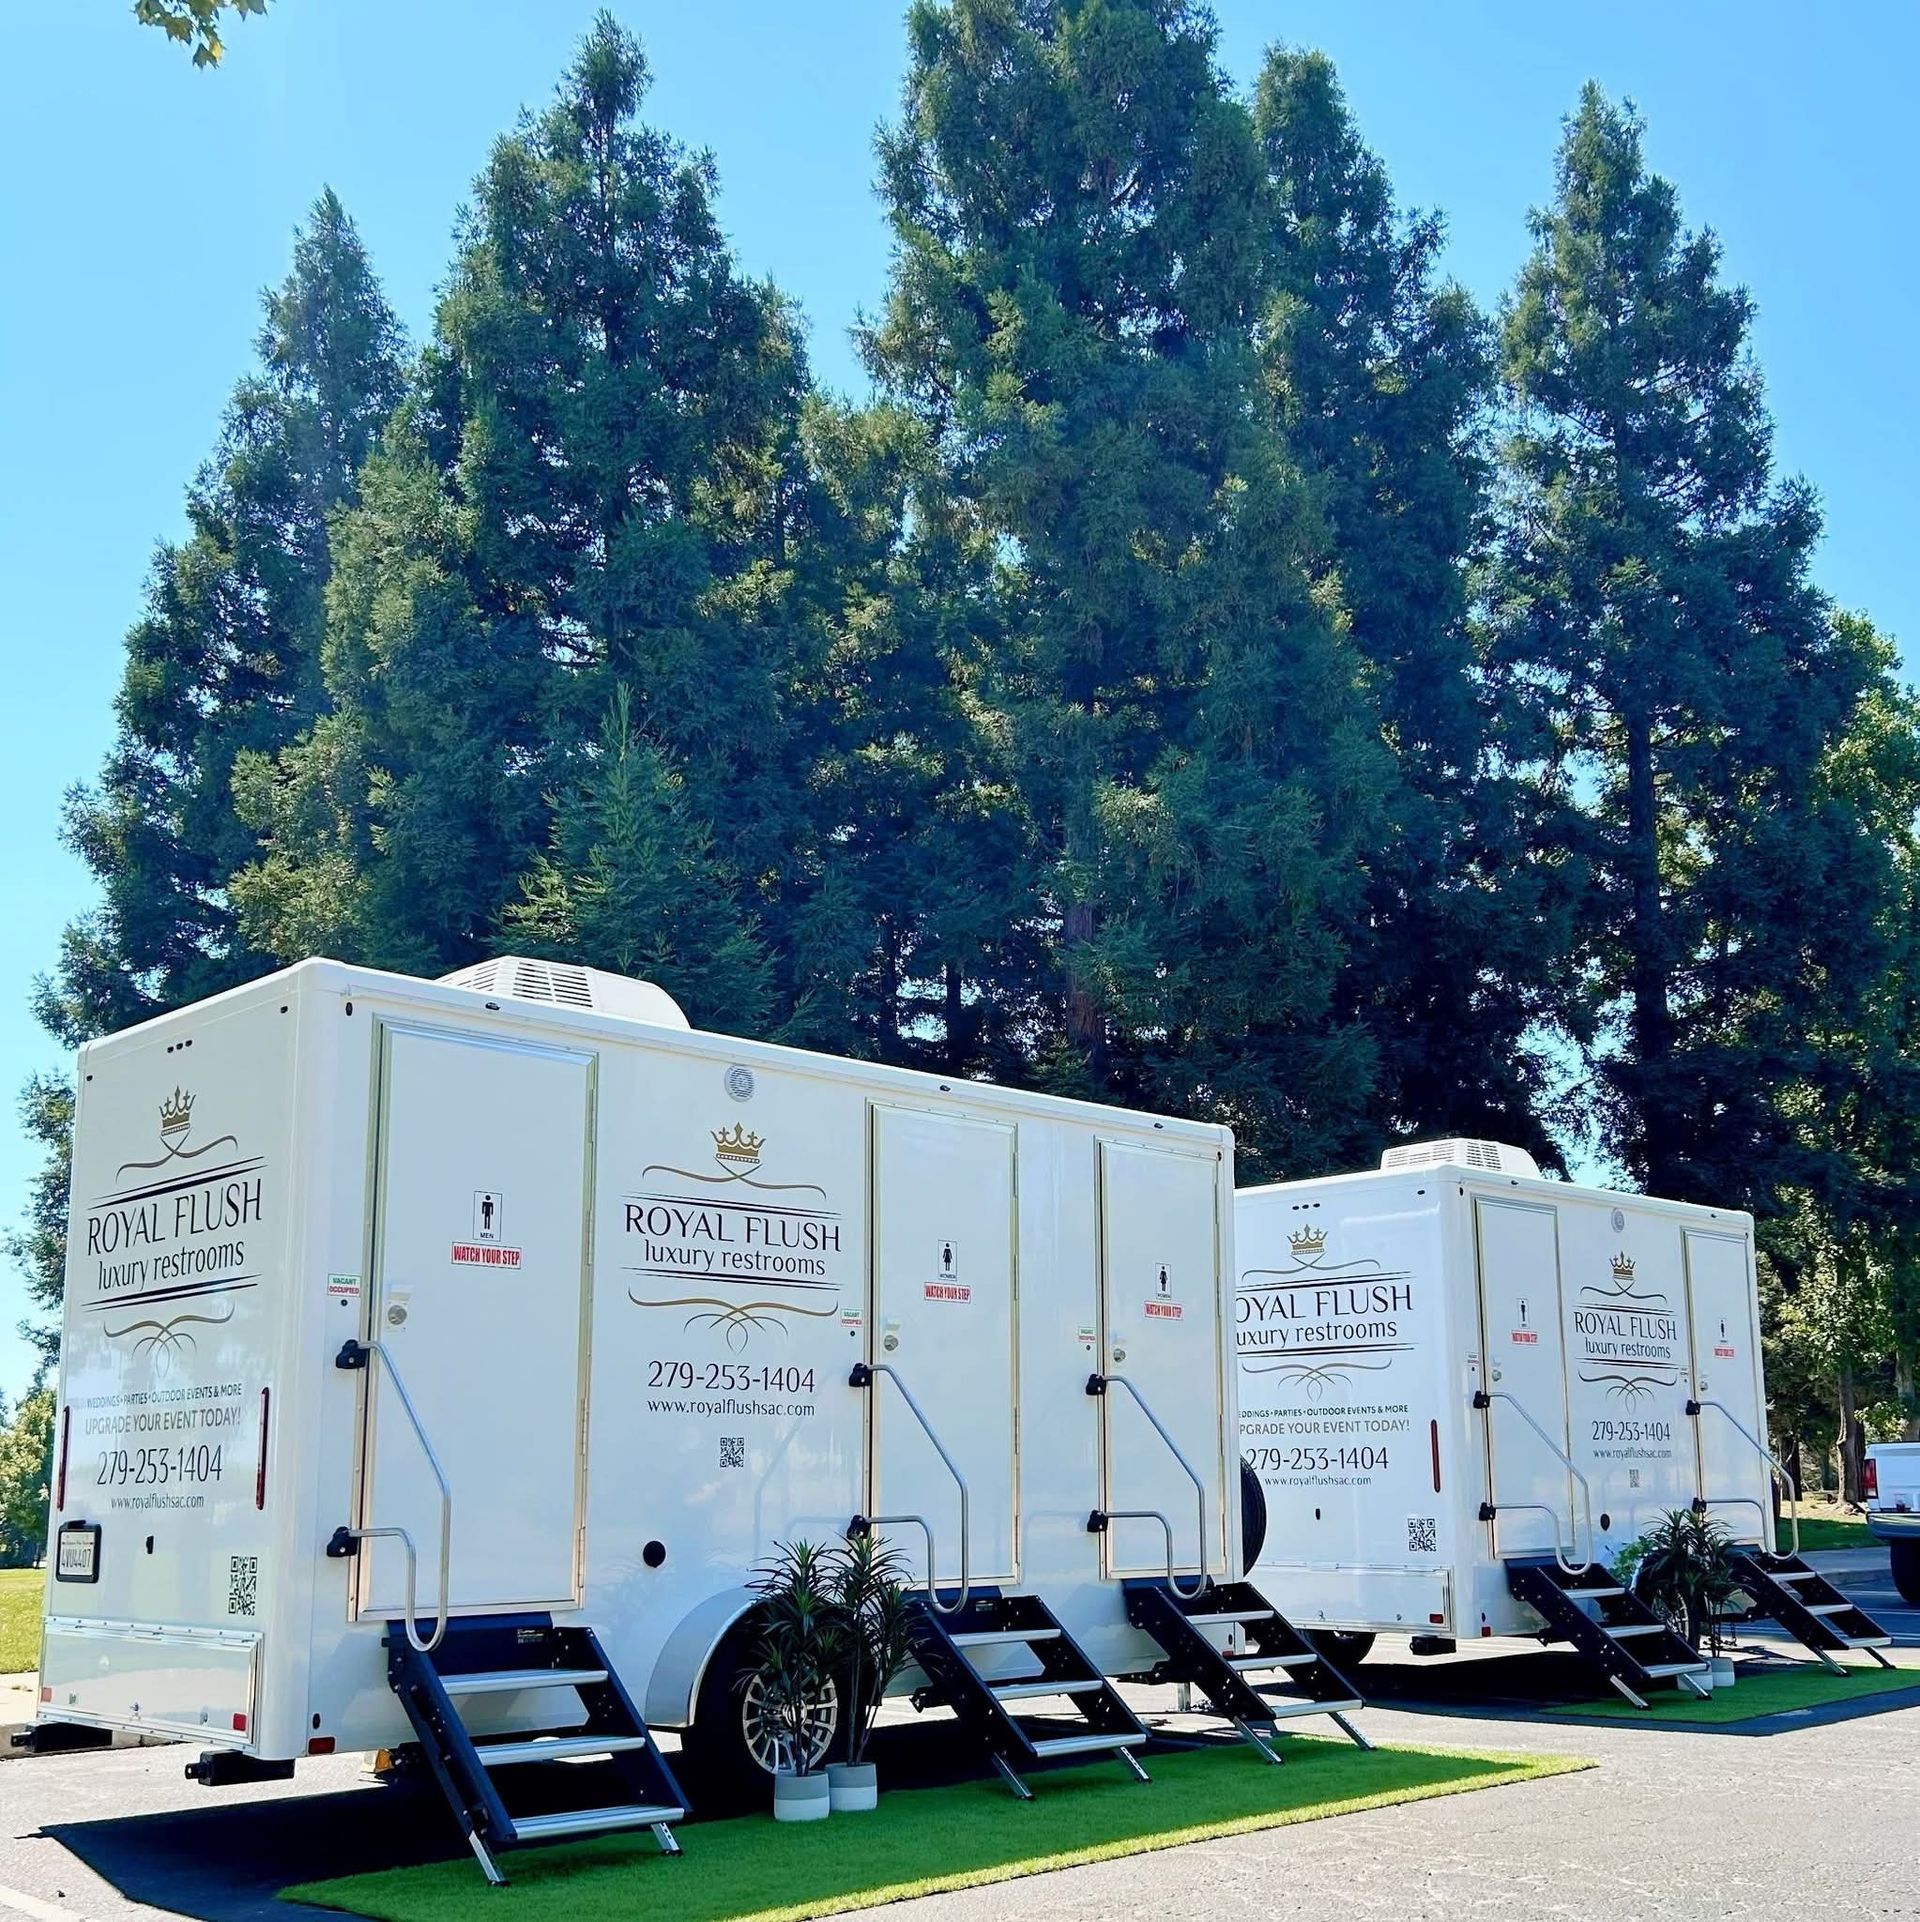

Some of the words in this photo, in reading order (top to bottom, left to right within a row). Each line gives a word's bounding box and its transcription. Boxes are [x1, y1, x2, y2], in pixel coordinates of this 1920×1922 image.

[88, 1203, 166, 1256] ROYAL
[174, 1178, 262, 1238] FLUSH
[624, 1203, 735, 1242] ROYAL
[744, 1216, 842, 1252] FLUSH
[98, 1257, 149, 1291] luxury
[153, 1241, 244, 1281] restrooms
[453, 1246, 480, 1262] WATCH
[482, 1248, 501, 1264] YOUR
[502, 1250, 520, 1266] STEP
[644, 1239, 715, 1272] luxury
[722, 1250, 826, 1276] restrooms
[329, 1286, 360, 1295] OCCUPIED
[332, 1277, 357, 1285] VACANT
[1236, 1293, 1307, 1324] OYAL
[1314, 1284, 1414, 1317] FLUSH
[1236, 1328, 1290, 1349] uxury
[1295, 1321, 1398, 1342] restrooms
[1573, 1311, 1627, 1336] ROYAL
[1630, 1317, 1677, 1340] FLUSH
[1584, 1337, 1618, 1356] luxury
[1621, 1342, 1671, 1359] restrooms
[647, 1360, 816, 1393] 279-253-1404
[187, 1386, 213, 1400] EVENTS
[213, 1386, 219, 1398] &
[220, 1383, 243, 1397] MORE
[647, 1399, 815, 1418] www.royalflushsac.com
[1347, 1405, 1376, 1415] EVENTS
[1377, 1405, 1383, 1414] &
[1384, 1404, 1409, 1413] MORE
[85, 1415, 131, 1435] UPGRADE
[132, 1412, 161, 1433] YOUR
[163, 1410, 198, 1430] EVENT
[200, 1407, 242, 1428] TODAY!
[1239, 1423, 1285, 1435] PGRADE
[1287, 1421, 1320, 1434] YOUR
[1323, 1420, 1361, 1433] EVENT
[1364, 1419, 1410, 1432] TODAY!
[1592, 1421, 1671, 1441] 279-253-1404
[97, 1444, 223, 1486] 279-253-1404
[1246, 1446, 1389, 1471] 279-253-1404
[1264, 1475, 1372, 1487] www.royalflushsac.com
[111, 1493, 205, 1513] www.royalflushsac.com
